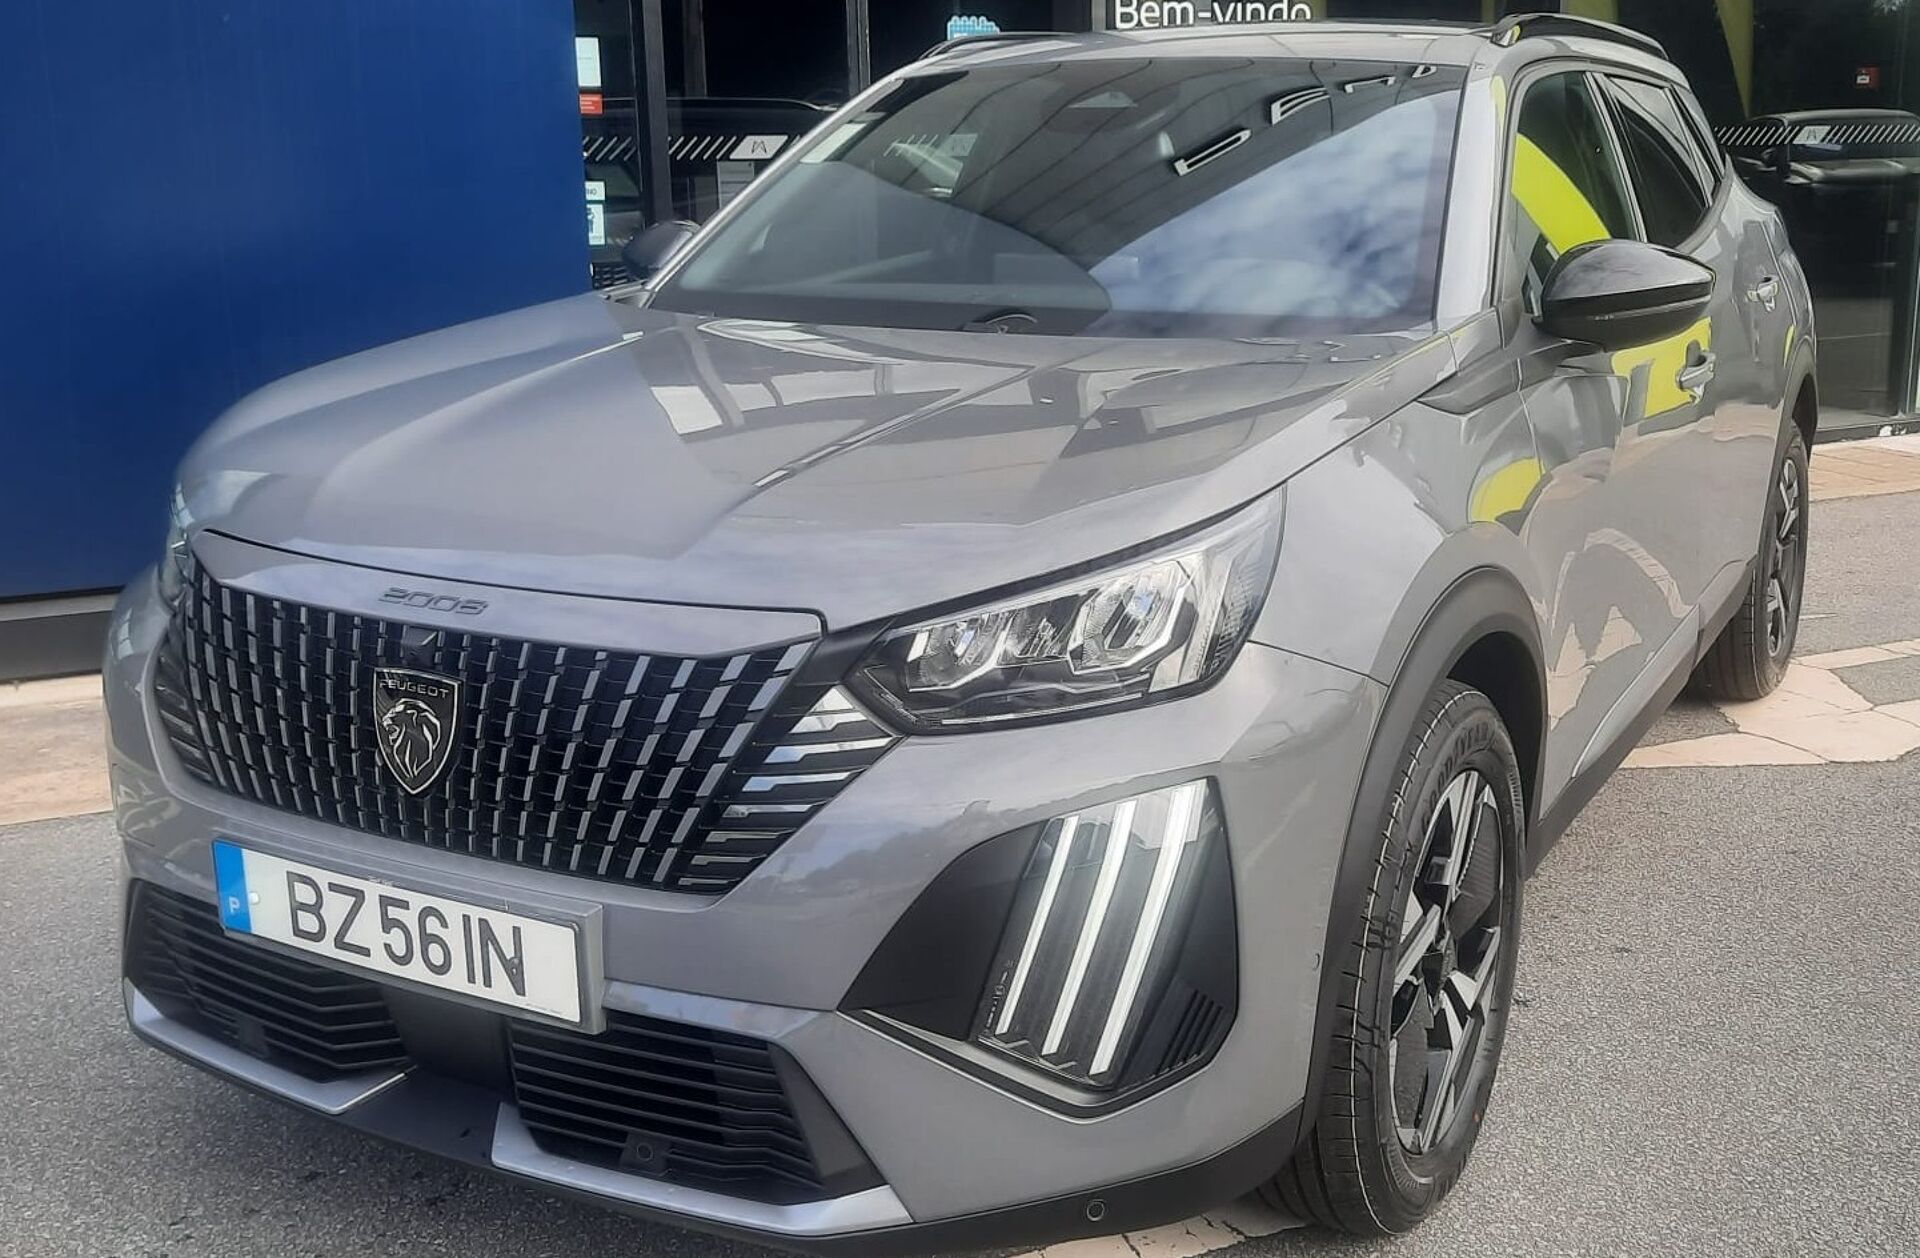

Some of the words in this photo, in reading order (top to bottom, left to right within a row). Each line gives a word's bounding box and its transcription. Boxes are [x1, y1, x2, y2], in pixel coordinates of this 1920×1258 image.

[379, 588, 488, 615] 2008
[380, 679, 449, 698] PEUGEOT
[229, 896, 240, 914] P
